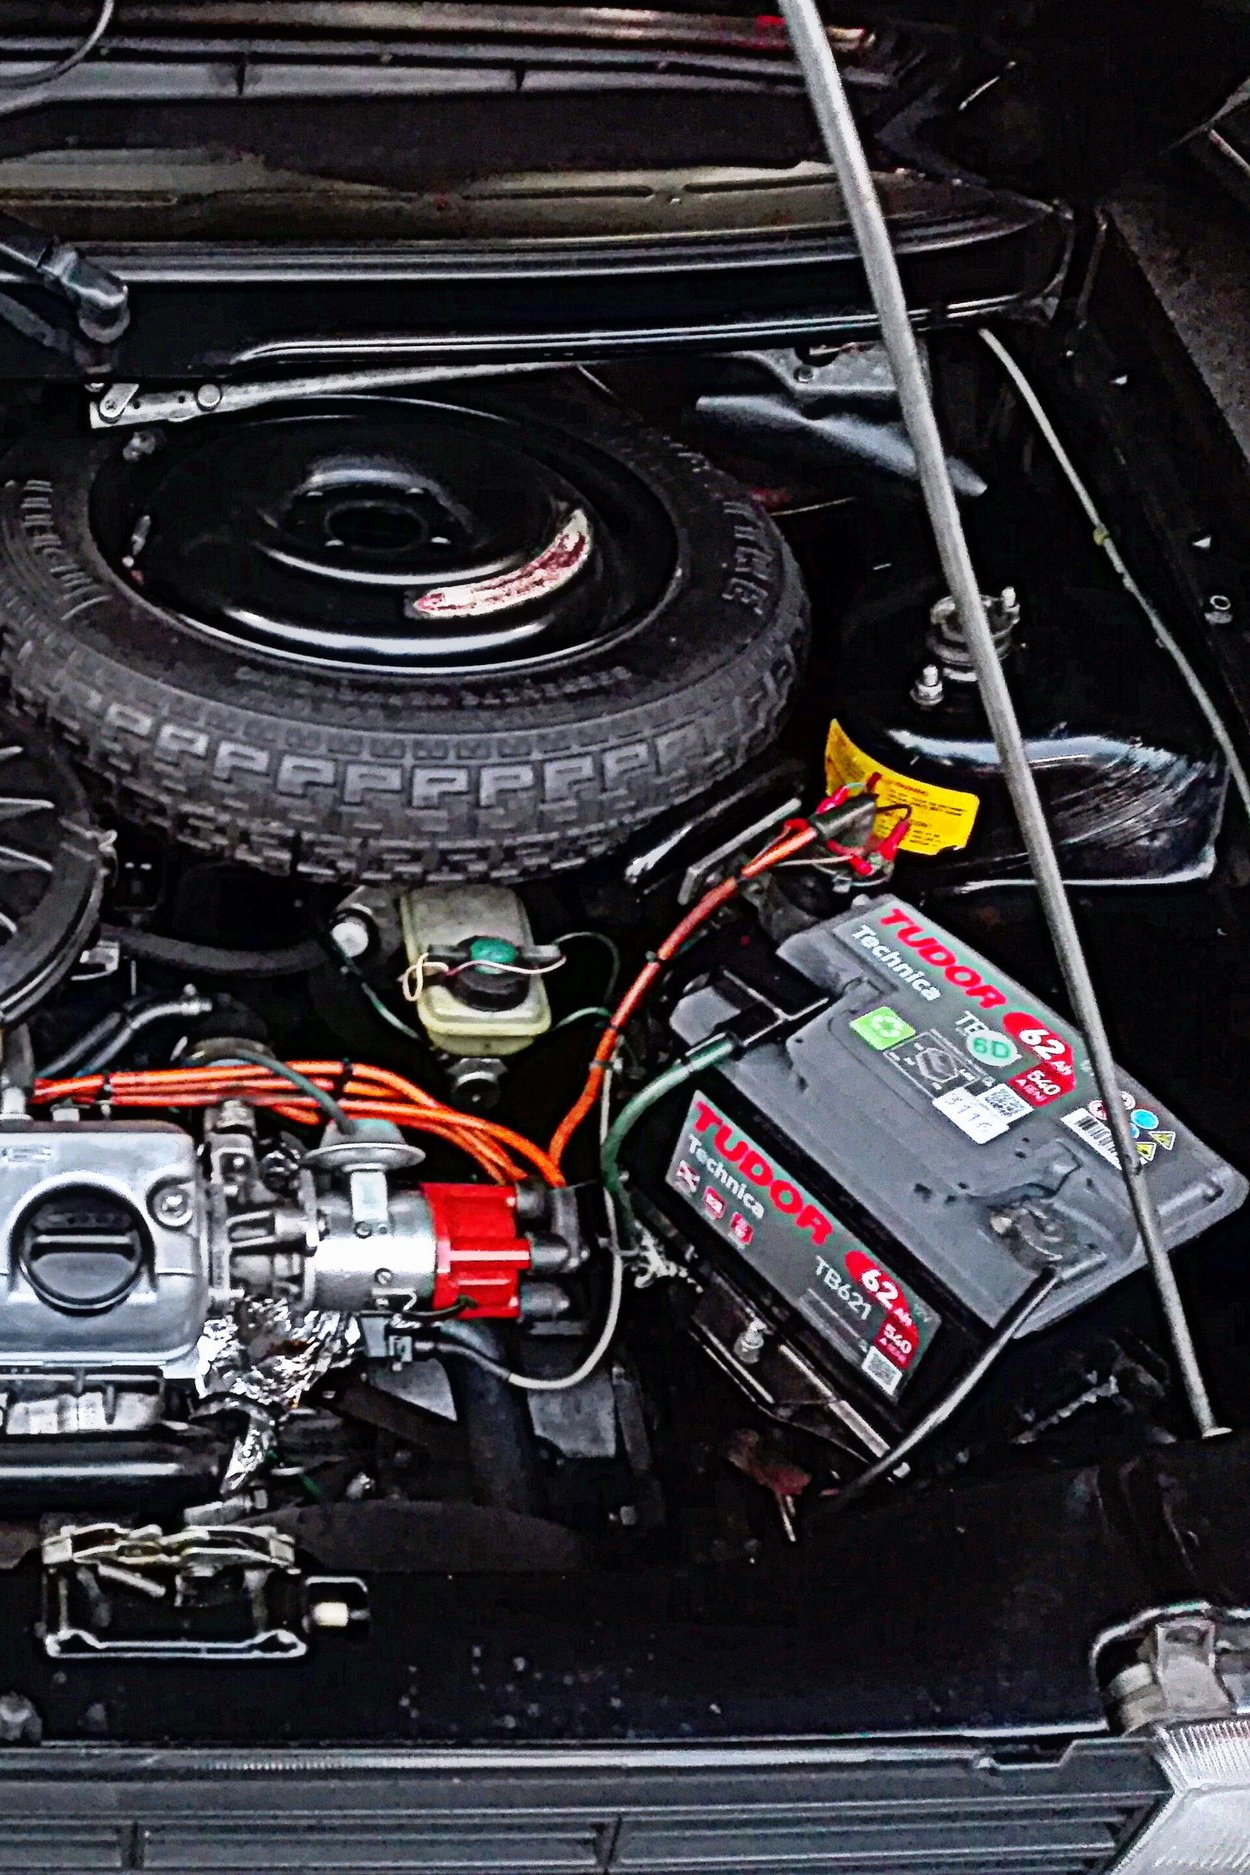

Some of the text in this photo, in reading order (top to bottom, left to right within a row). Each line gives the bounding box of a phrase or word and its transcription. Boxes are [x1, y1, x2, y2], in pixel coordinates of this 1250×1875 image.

[852, 924, 941, 1001] Technica
[879, 908, 1007, 1009] TUDOR
[1019, 1029, 1066, 1060] 62
[1027, 1069, 1061, 1095] 540
[688, 1134, 765, 1219] Technica
[693, 1101, 833, 1245] TUDOR
[814, 1255, 872, 1320] TB621
[861, 1269, 898, 1310] 62
[884, 1323, 912, 1354] 540
